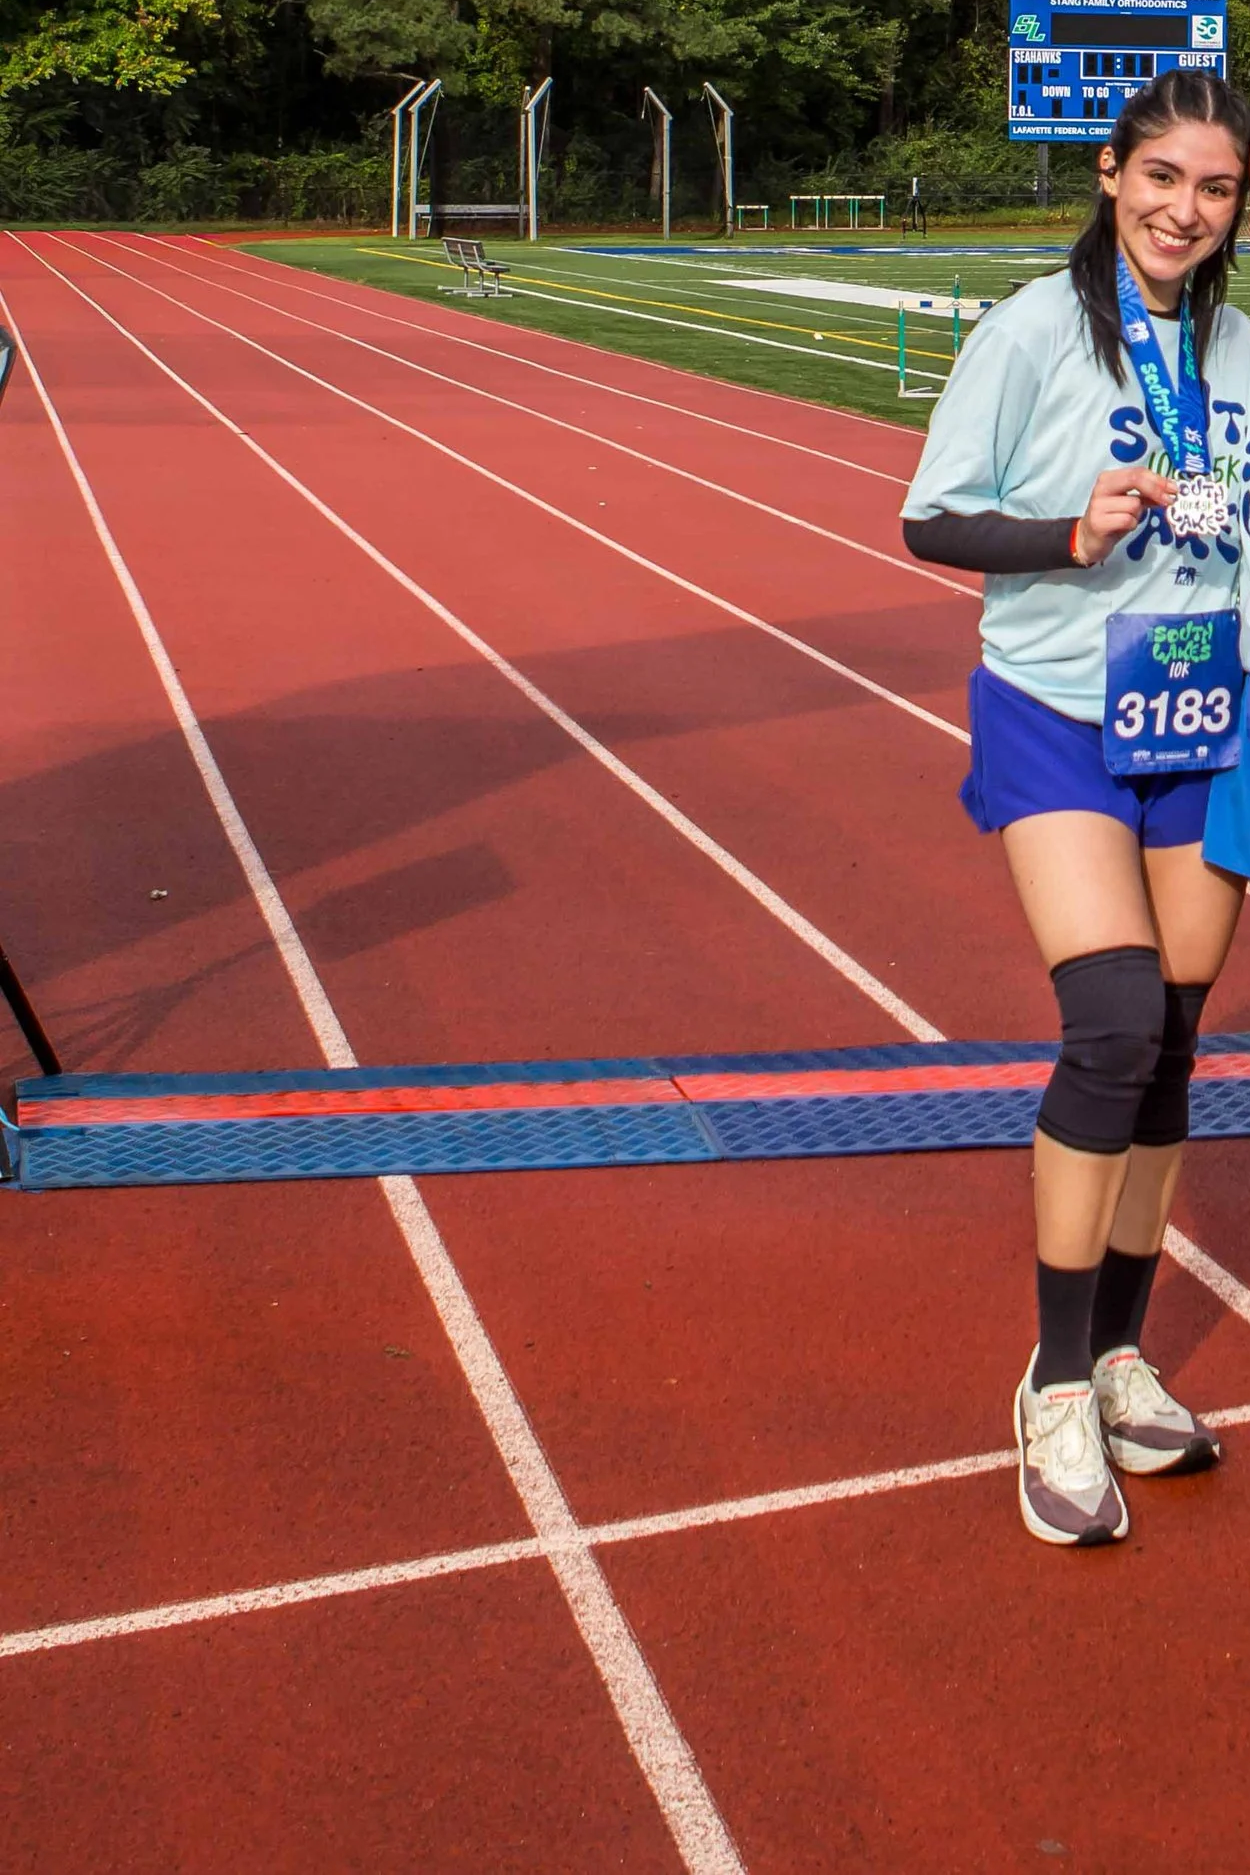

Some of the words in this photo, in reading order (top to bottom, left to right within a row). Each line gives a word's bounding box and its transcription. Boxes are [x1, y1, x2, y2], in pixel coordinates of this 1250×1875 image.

[1117, 0, 1187, 9] ORTHODONTICS
[1012, 14, 1046, 42] SL
[1014, 50, 1061, 64] SEAHAWKS
[1178, 54, 1218, 67] GUEST
[1042, 85, 1071, 98] DOWN
[1082, 86, 1095, 98] TO
[1096, 86, 1110, 98] GO
[1011, 105, 1035, 117] T.O.L.
[1012, 126, 1052, 134] LAFAYETTE
[1054, 126, 1087, 135] FEDERAL
[1184, 426, 1203, 446] 5K
[1185, 452, 1206, 473] 10K
[1176, 477, 1224, 504] OUTH
[1153, 620, 1213, 644] SOUTH
[1152, 641, 1212, 665] LAKES
[1169, 660, 1191, 678] 10K
[1114, 686, 1232, 739] 3183
